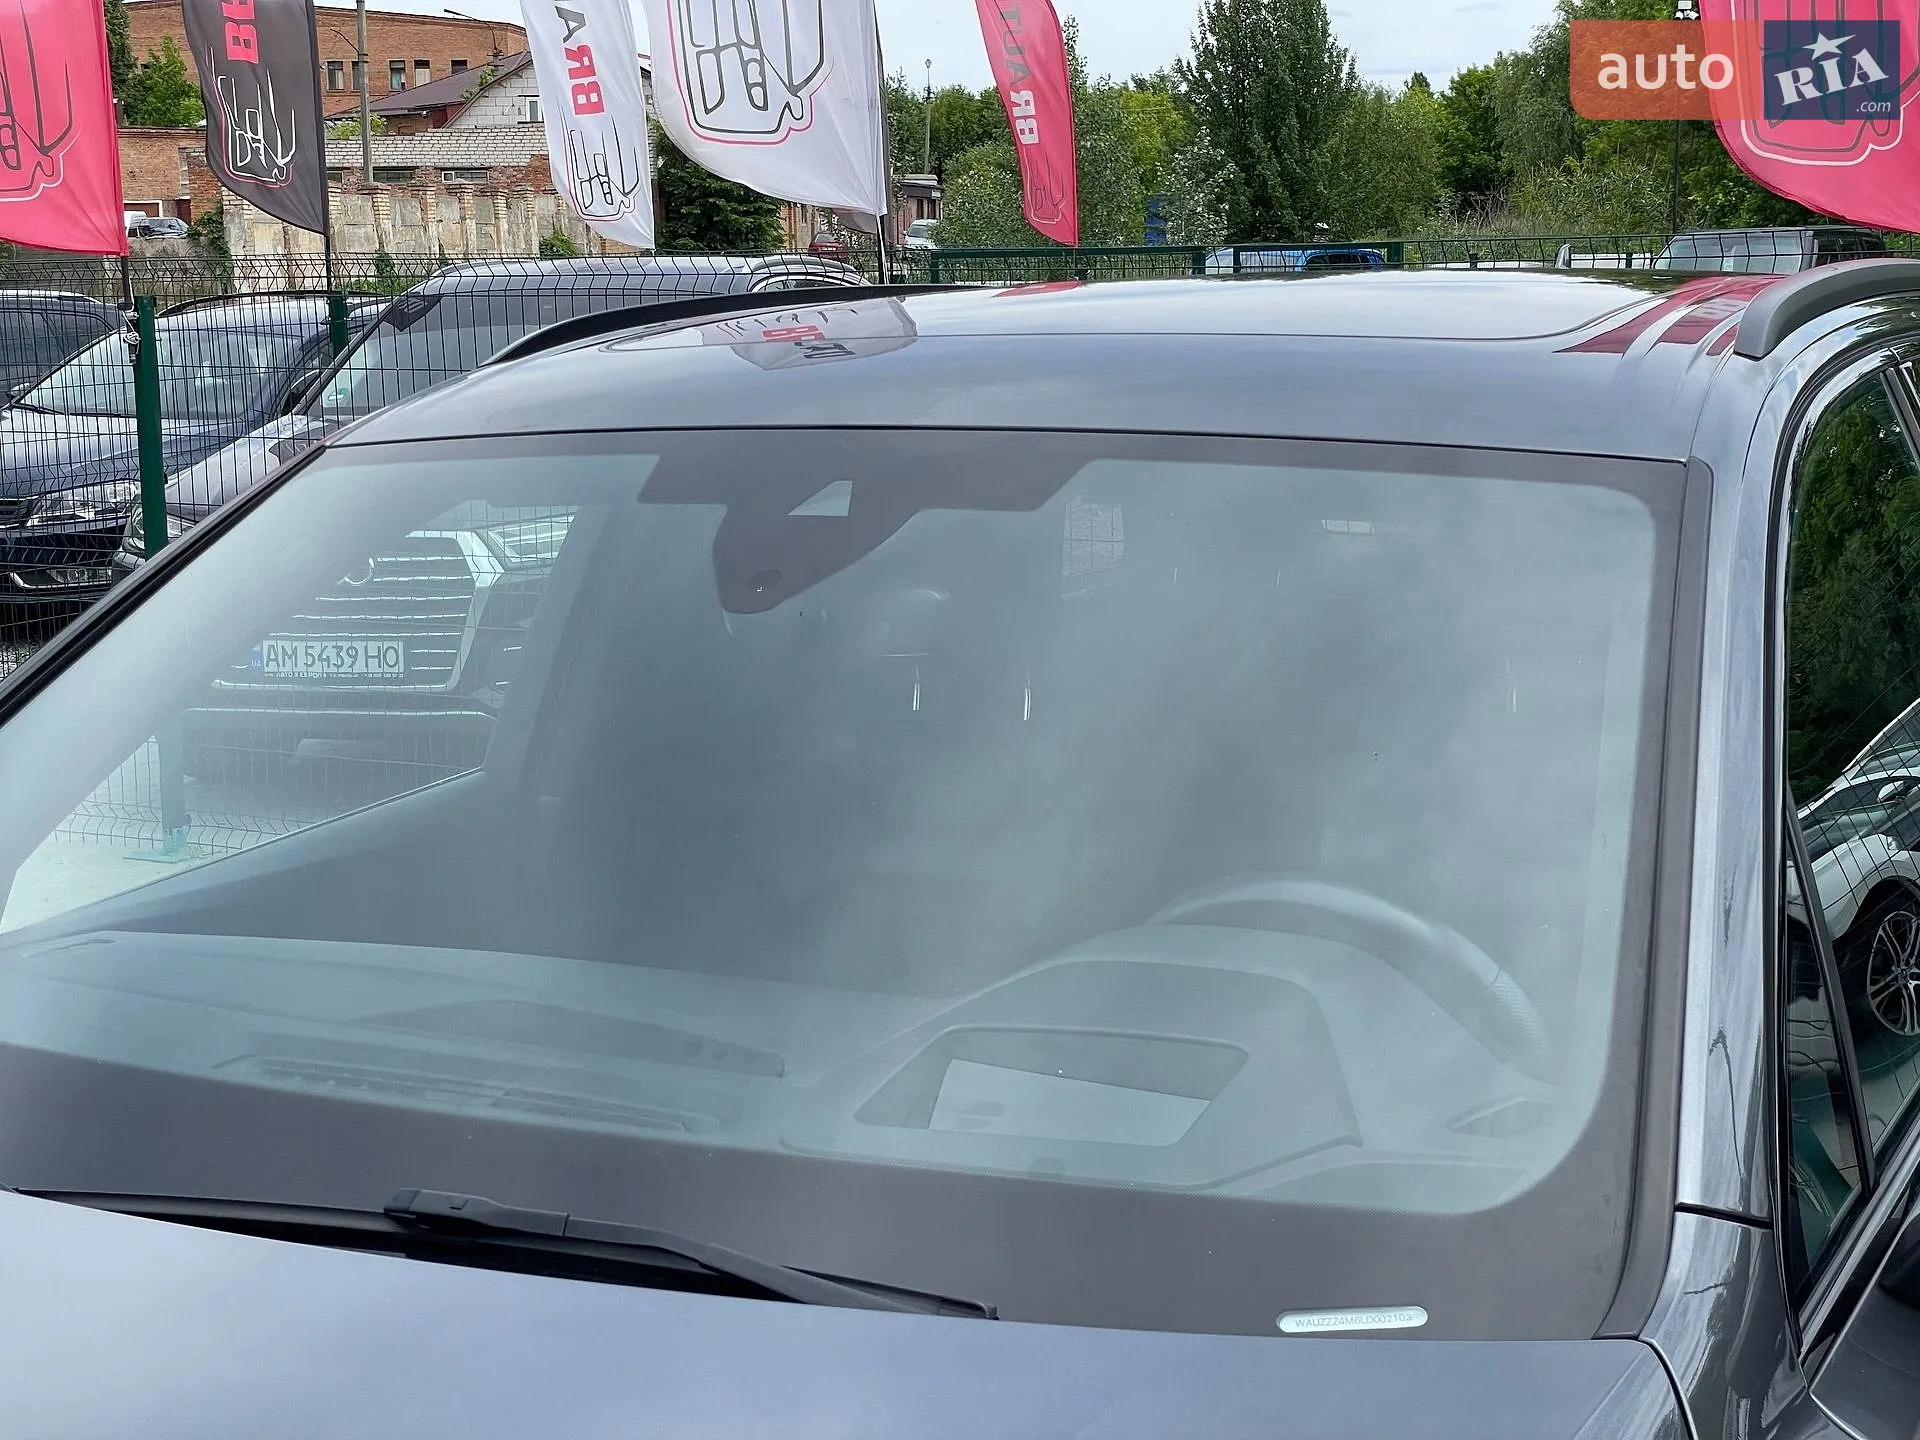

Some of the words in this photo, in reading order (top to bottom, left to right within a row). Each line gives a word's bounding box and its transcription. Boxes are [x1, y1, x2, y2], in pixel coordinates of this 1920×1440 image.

[265, 644, 298, 668] AM
[304, 645, 359, 668] 5439
[364, 645, 400, 669] HO
